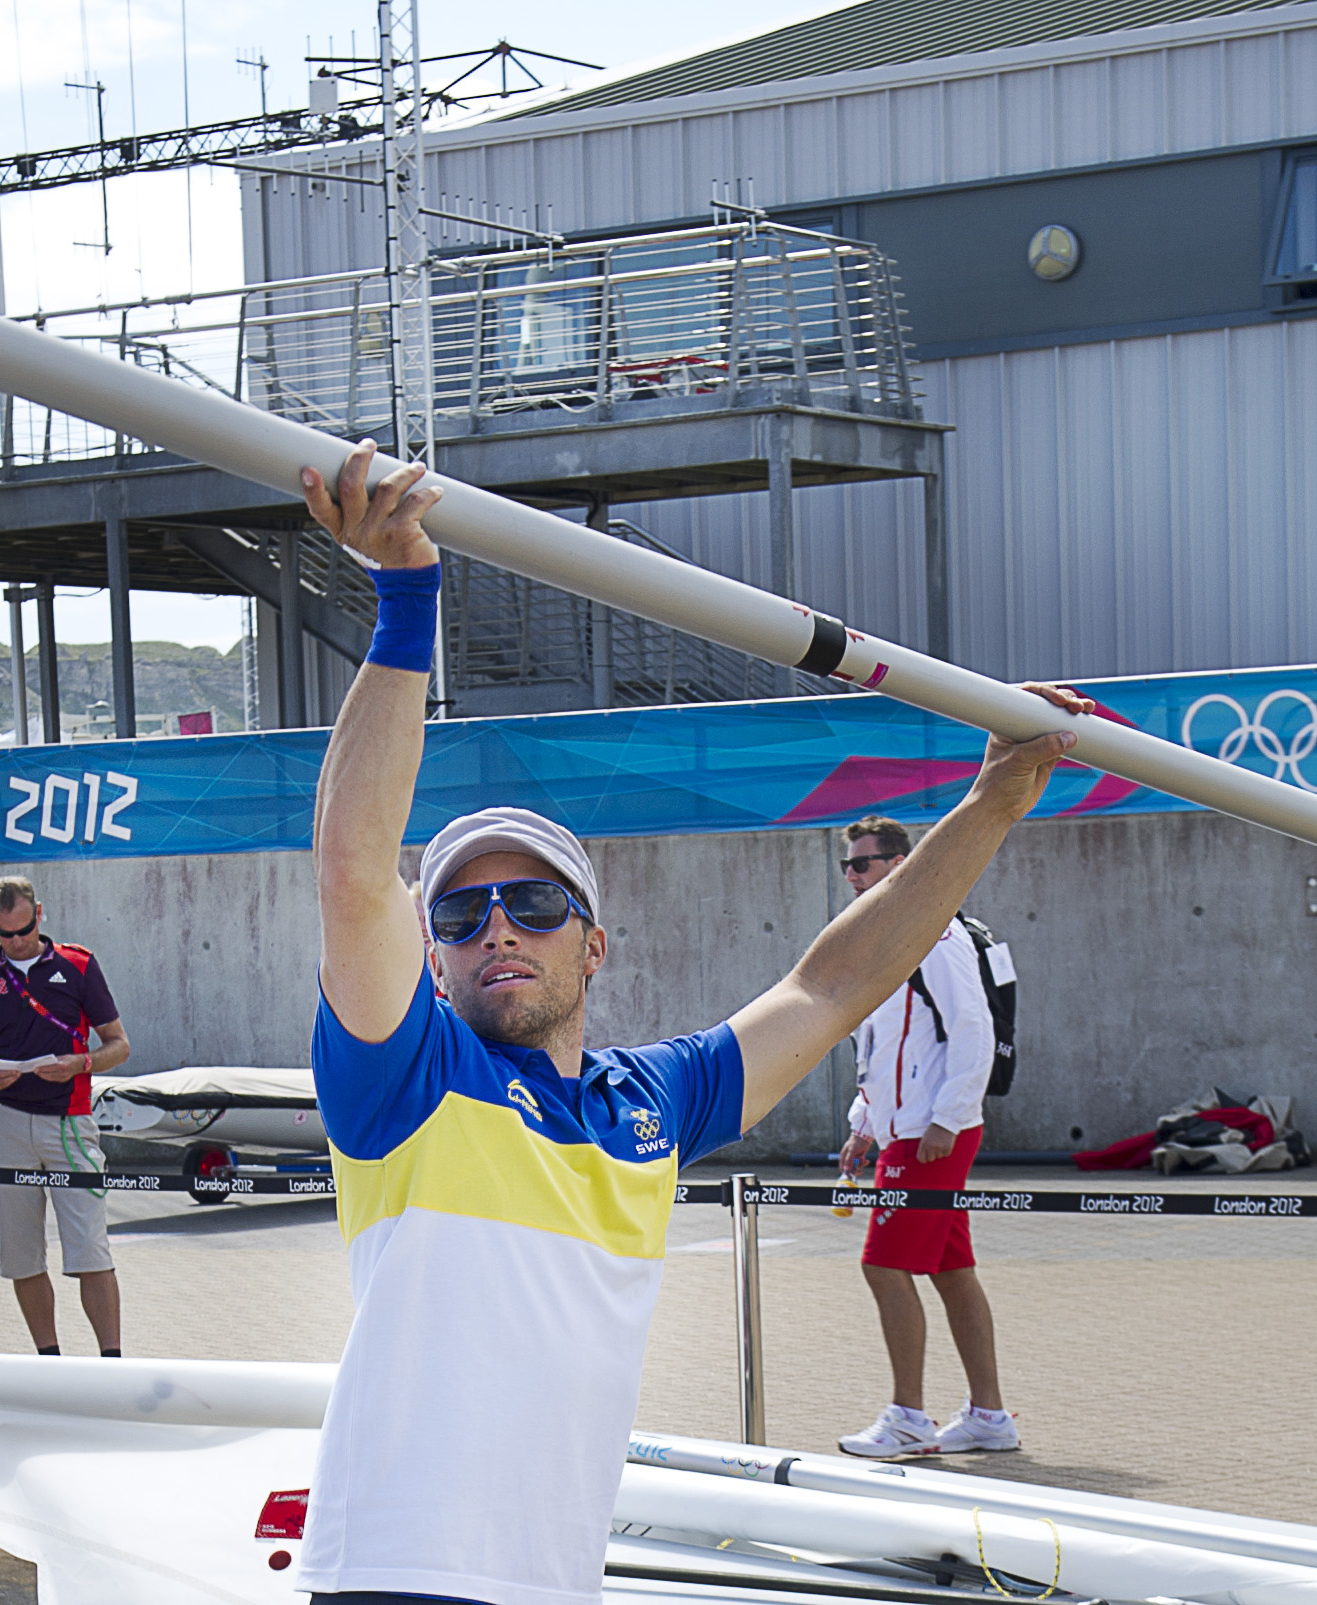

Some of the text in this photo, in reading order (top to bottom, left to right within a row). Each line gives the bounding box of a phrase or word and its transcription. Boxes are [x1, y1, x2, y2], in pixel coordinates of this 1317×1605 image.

[5, 771, 138, 845] 2012
[635, 1138, 671, 1156] SWE
[14, 1170, 70, 1187] London 2012
[102, 1174, 160, 1190] London 2012
[194, 1177, 254, 1193] London 2012
[289, 1178, 326, 1193] London
[761, 1187, 790, 1204] 2012
[832, 1188, 909, 1207] London 2012
[953, 1192, 1033, 1210] London 2012
[1080, 1194, 1165, 1212] London 2012
[1214, 1196, 1303, 1215] London 2012
